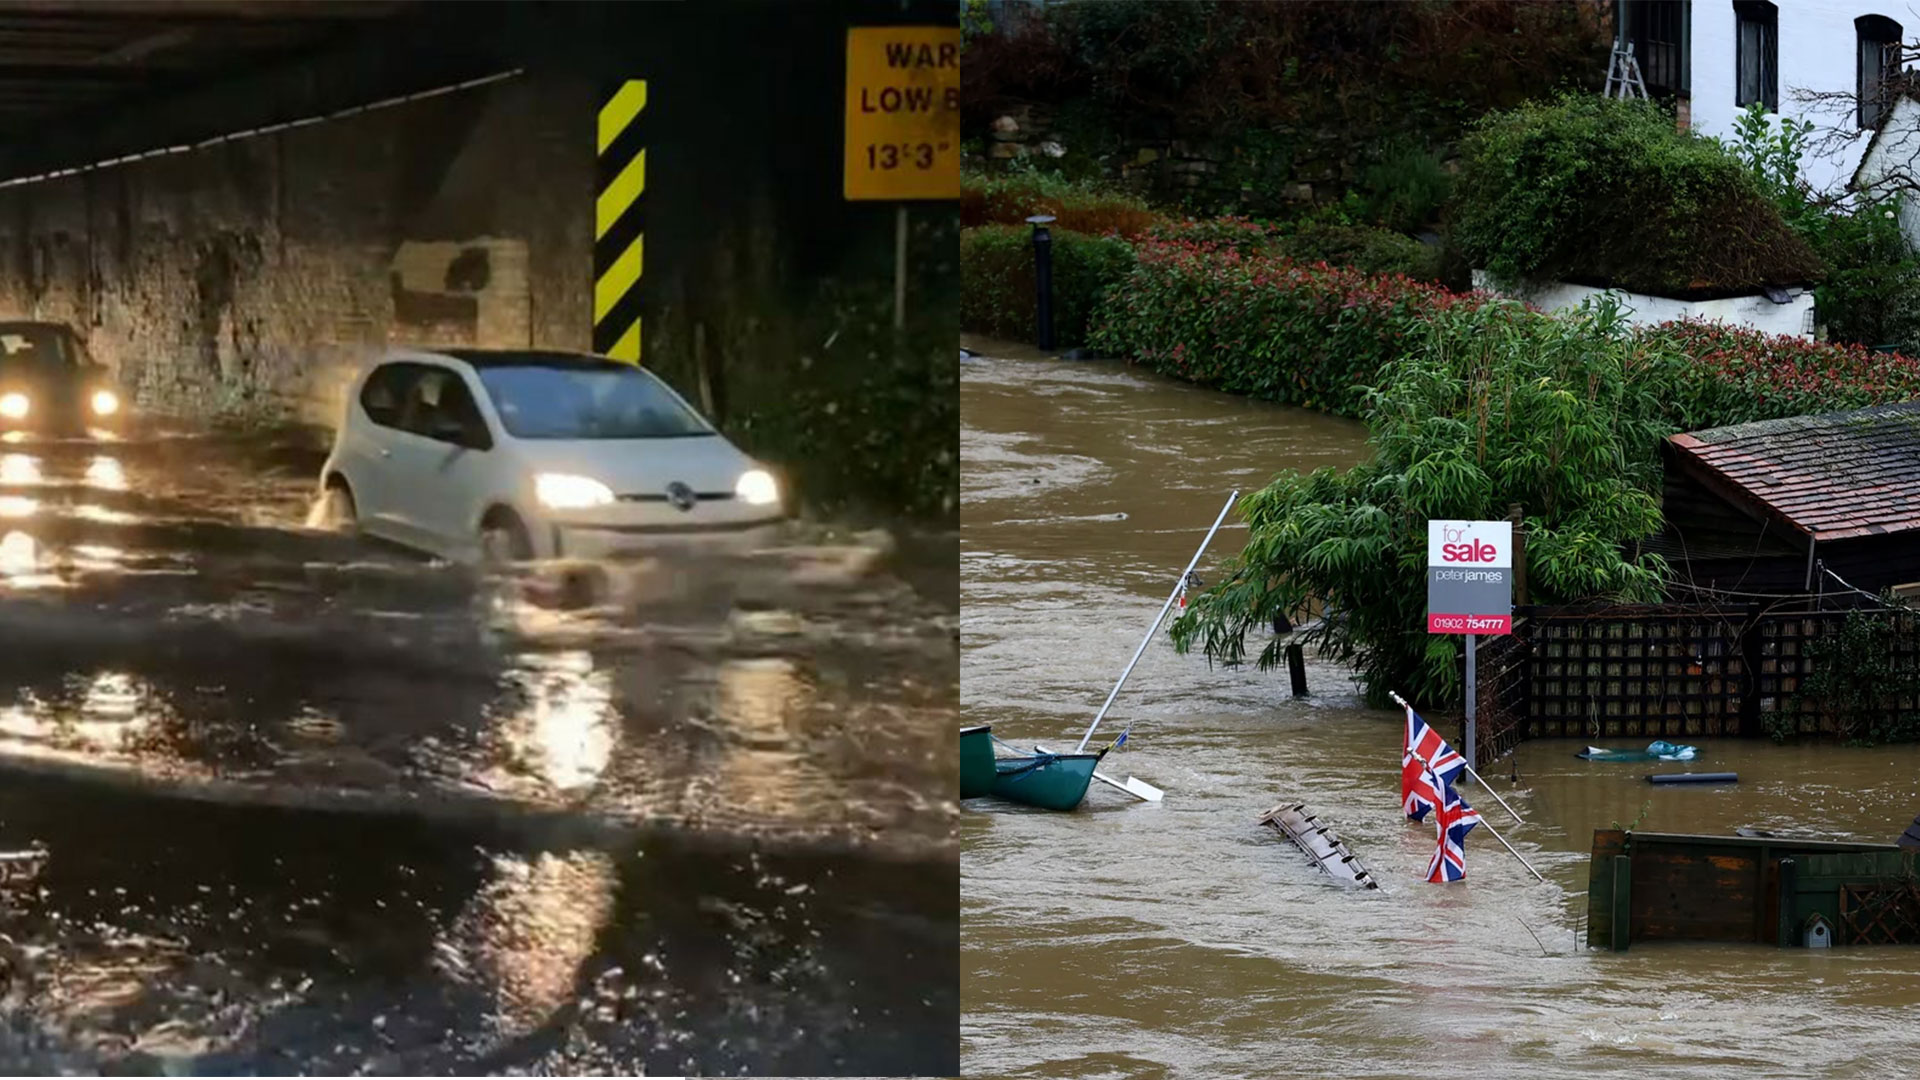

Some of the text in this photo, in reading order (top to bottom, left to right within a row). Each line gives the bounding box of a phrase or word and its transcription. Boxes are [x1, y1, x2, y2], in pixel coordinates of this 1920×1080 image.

[886, 43, 958, 68] WAR
[861, 87, 932, 114] LOW
[1443, 524, 1466, 543] for
[1442, 538, 1497, 562] sale
[1434, 618, 1504, 629] 01902 754777
